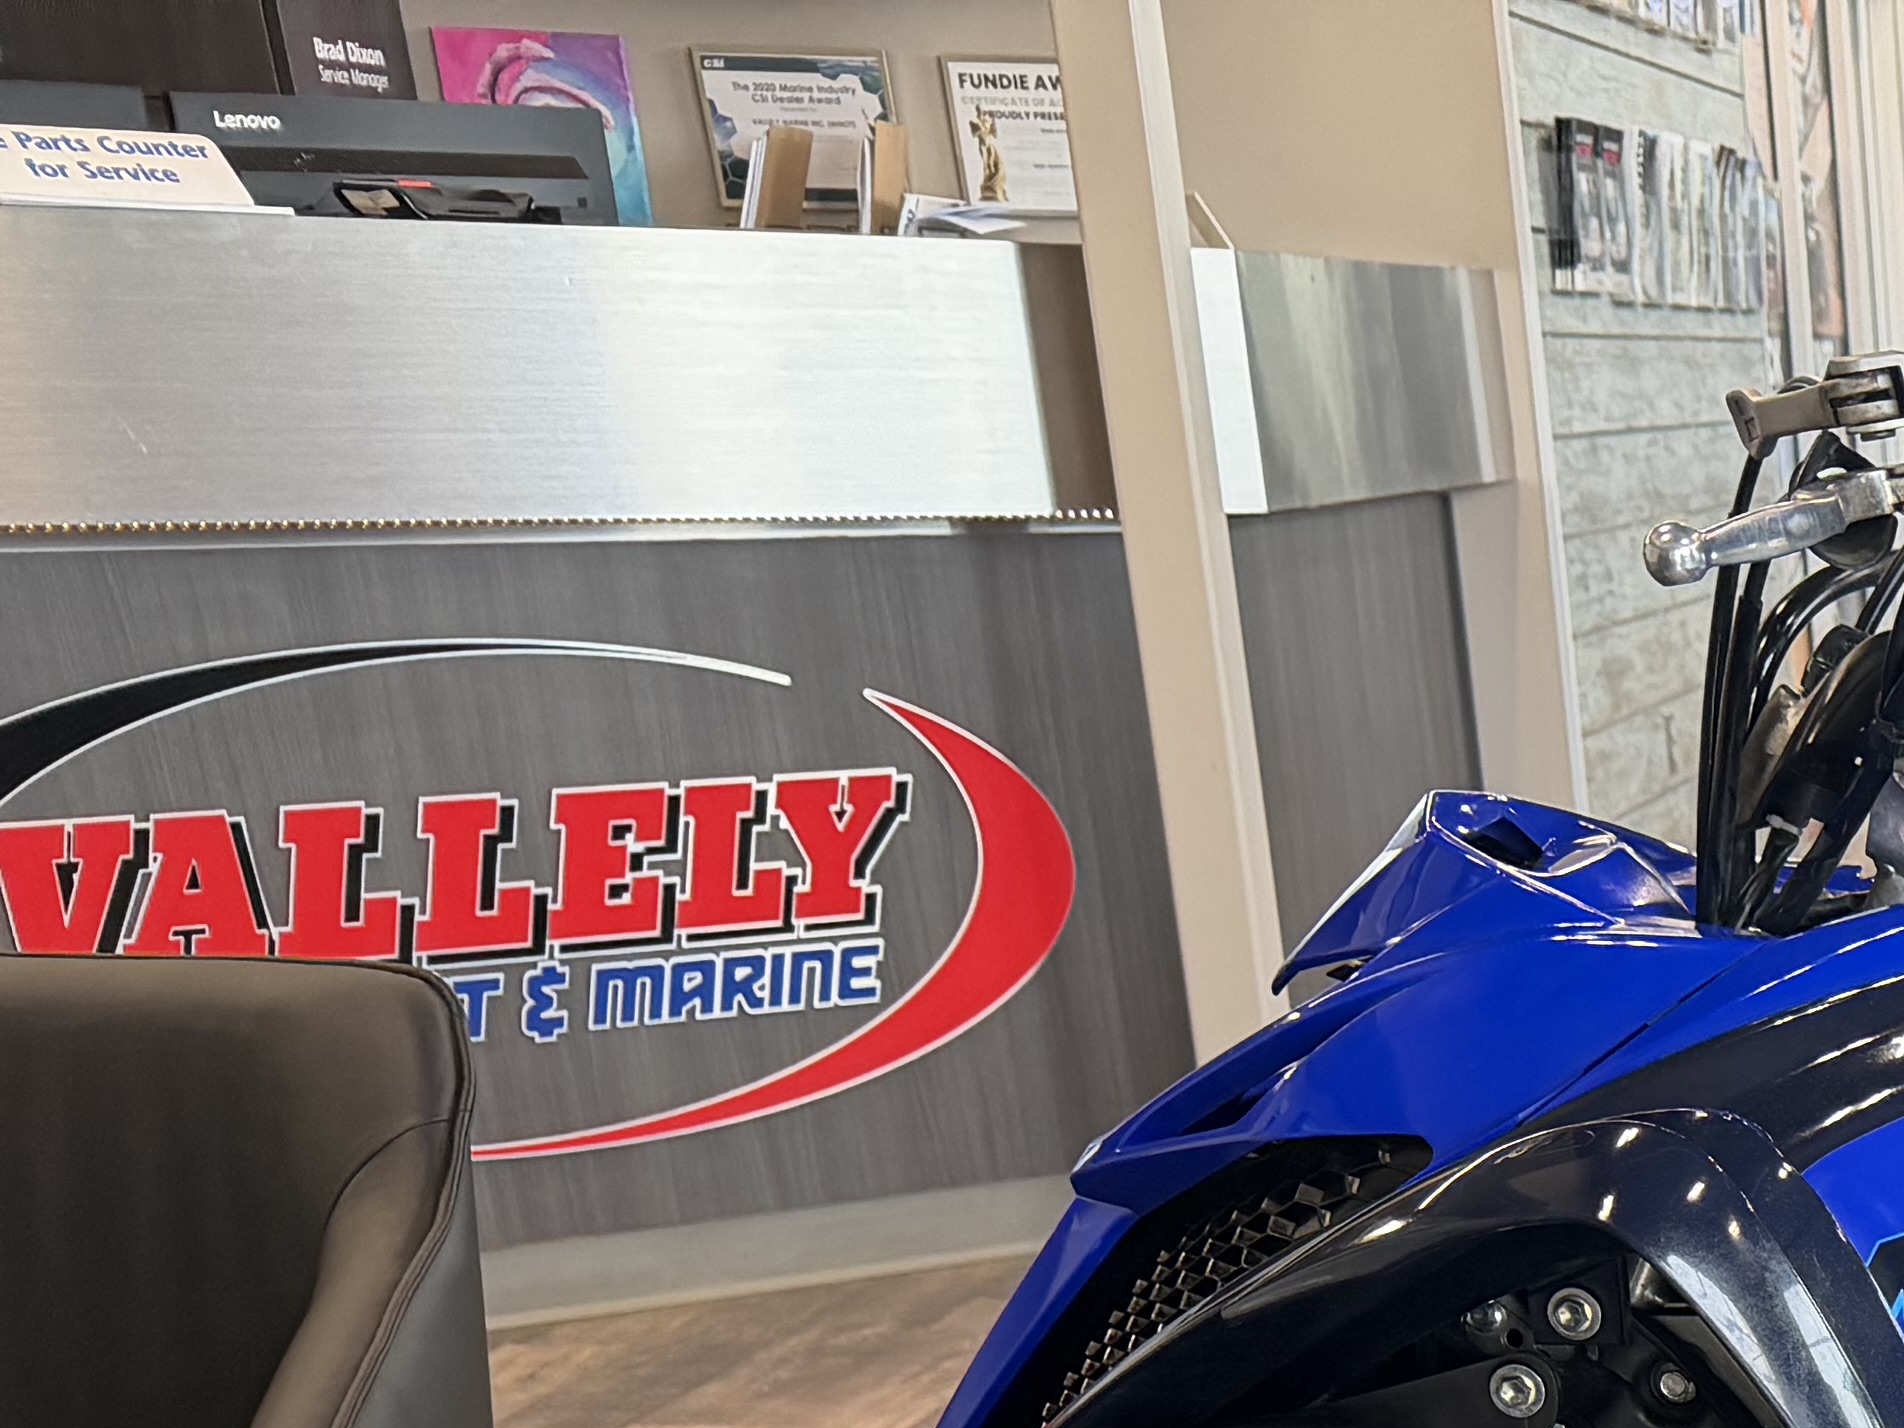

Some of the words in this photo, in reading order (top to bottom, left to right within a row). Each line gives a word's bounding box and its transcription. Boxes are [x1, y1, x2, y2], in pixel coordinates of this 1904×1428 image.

[313, 36, 347, 63] Brad
[347, 41, 387, 69] Dixon
[318, 65, 350, 88] Service
[351, 67, 391, 93] Manager
[779, 82, 814, 94] Marine
[816, 83, 857, 96] Industry
[958, 72, 1030, 91] FUNDIE
[771, 94, 805, 105] Dealer
[807, 94, 842, 105] Award
[213, 110, 282, 132] Lenovo
[11, 130, 92, 152] Parts
[96, 134, 210, 160] Counter
[23, 157, 71, 179] for
[76, 160, 182, 184] Service
[0, 767, 912, 968] VALLELY
[520, 959, 571, 1043] &
[591, 938, 884, 1031] MARINE
